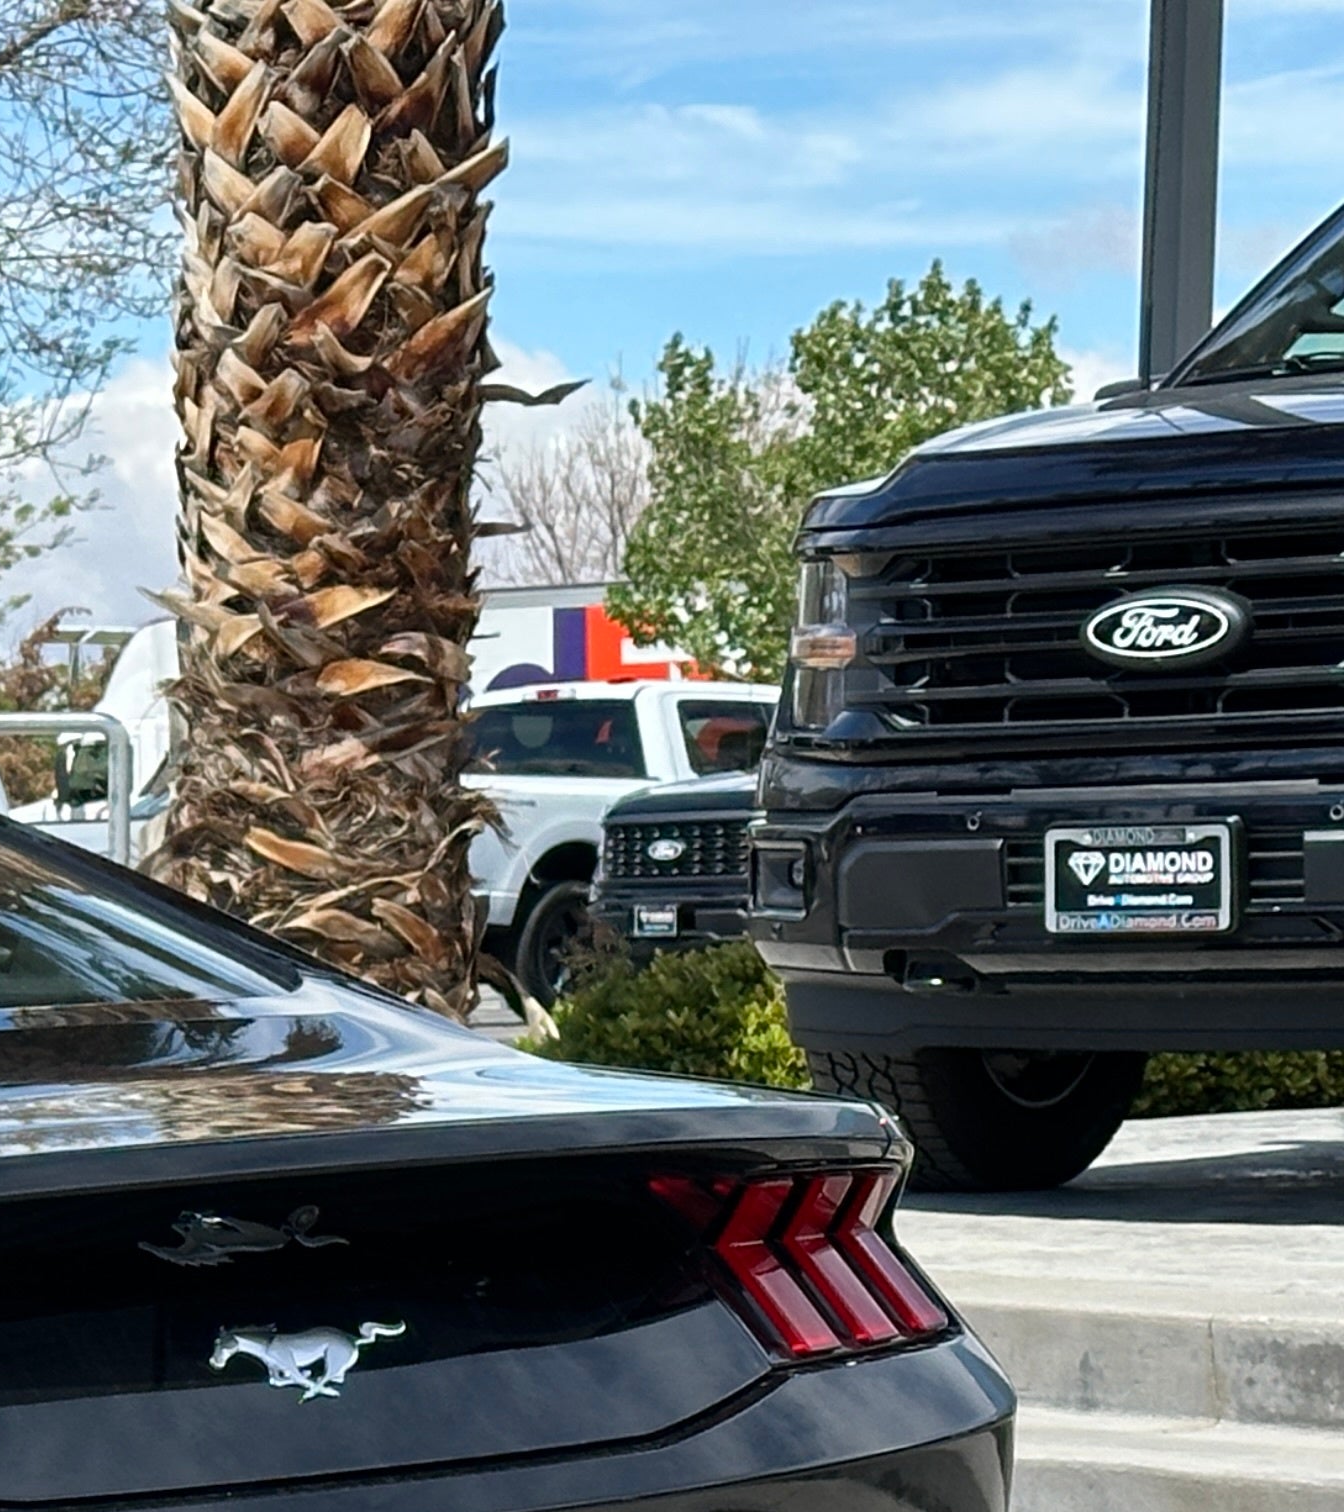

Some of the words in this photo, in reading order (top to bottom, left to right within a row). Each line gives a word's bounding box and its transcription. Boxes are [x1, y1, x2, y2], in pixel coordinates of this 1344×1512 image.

[1113, 607, 1200, 648] Ford
[1093, 829, 1154, 844] DIAMOND
[1109, 851, 1214, 873] DIAMOND
